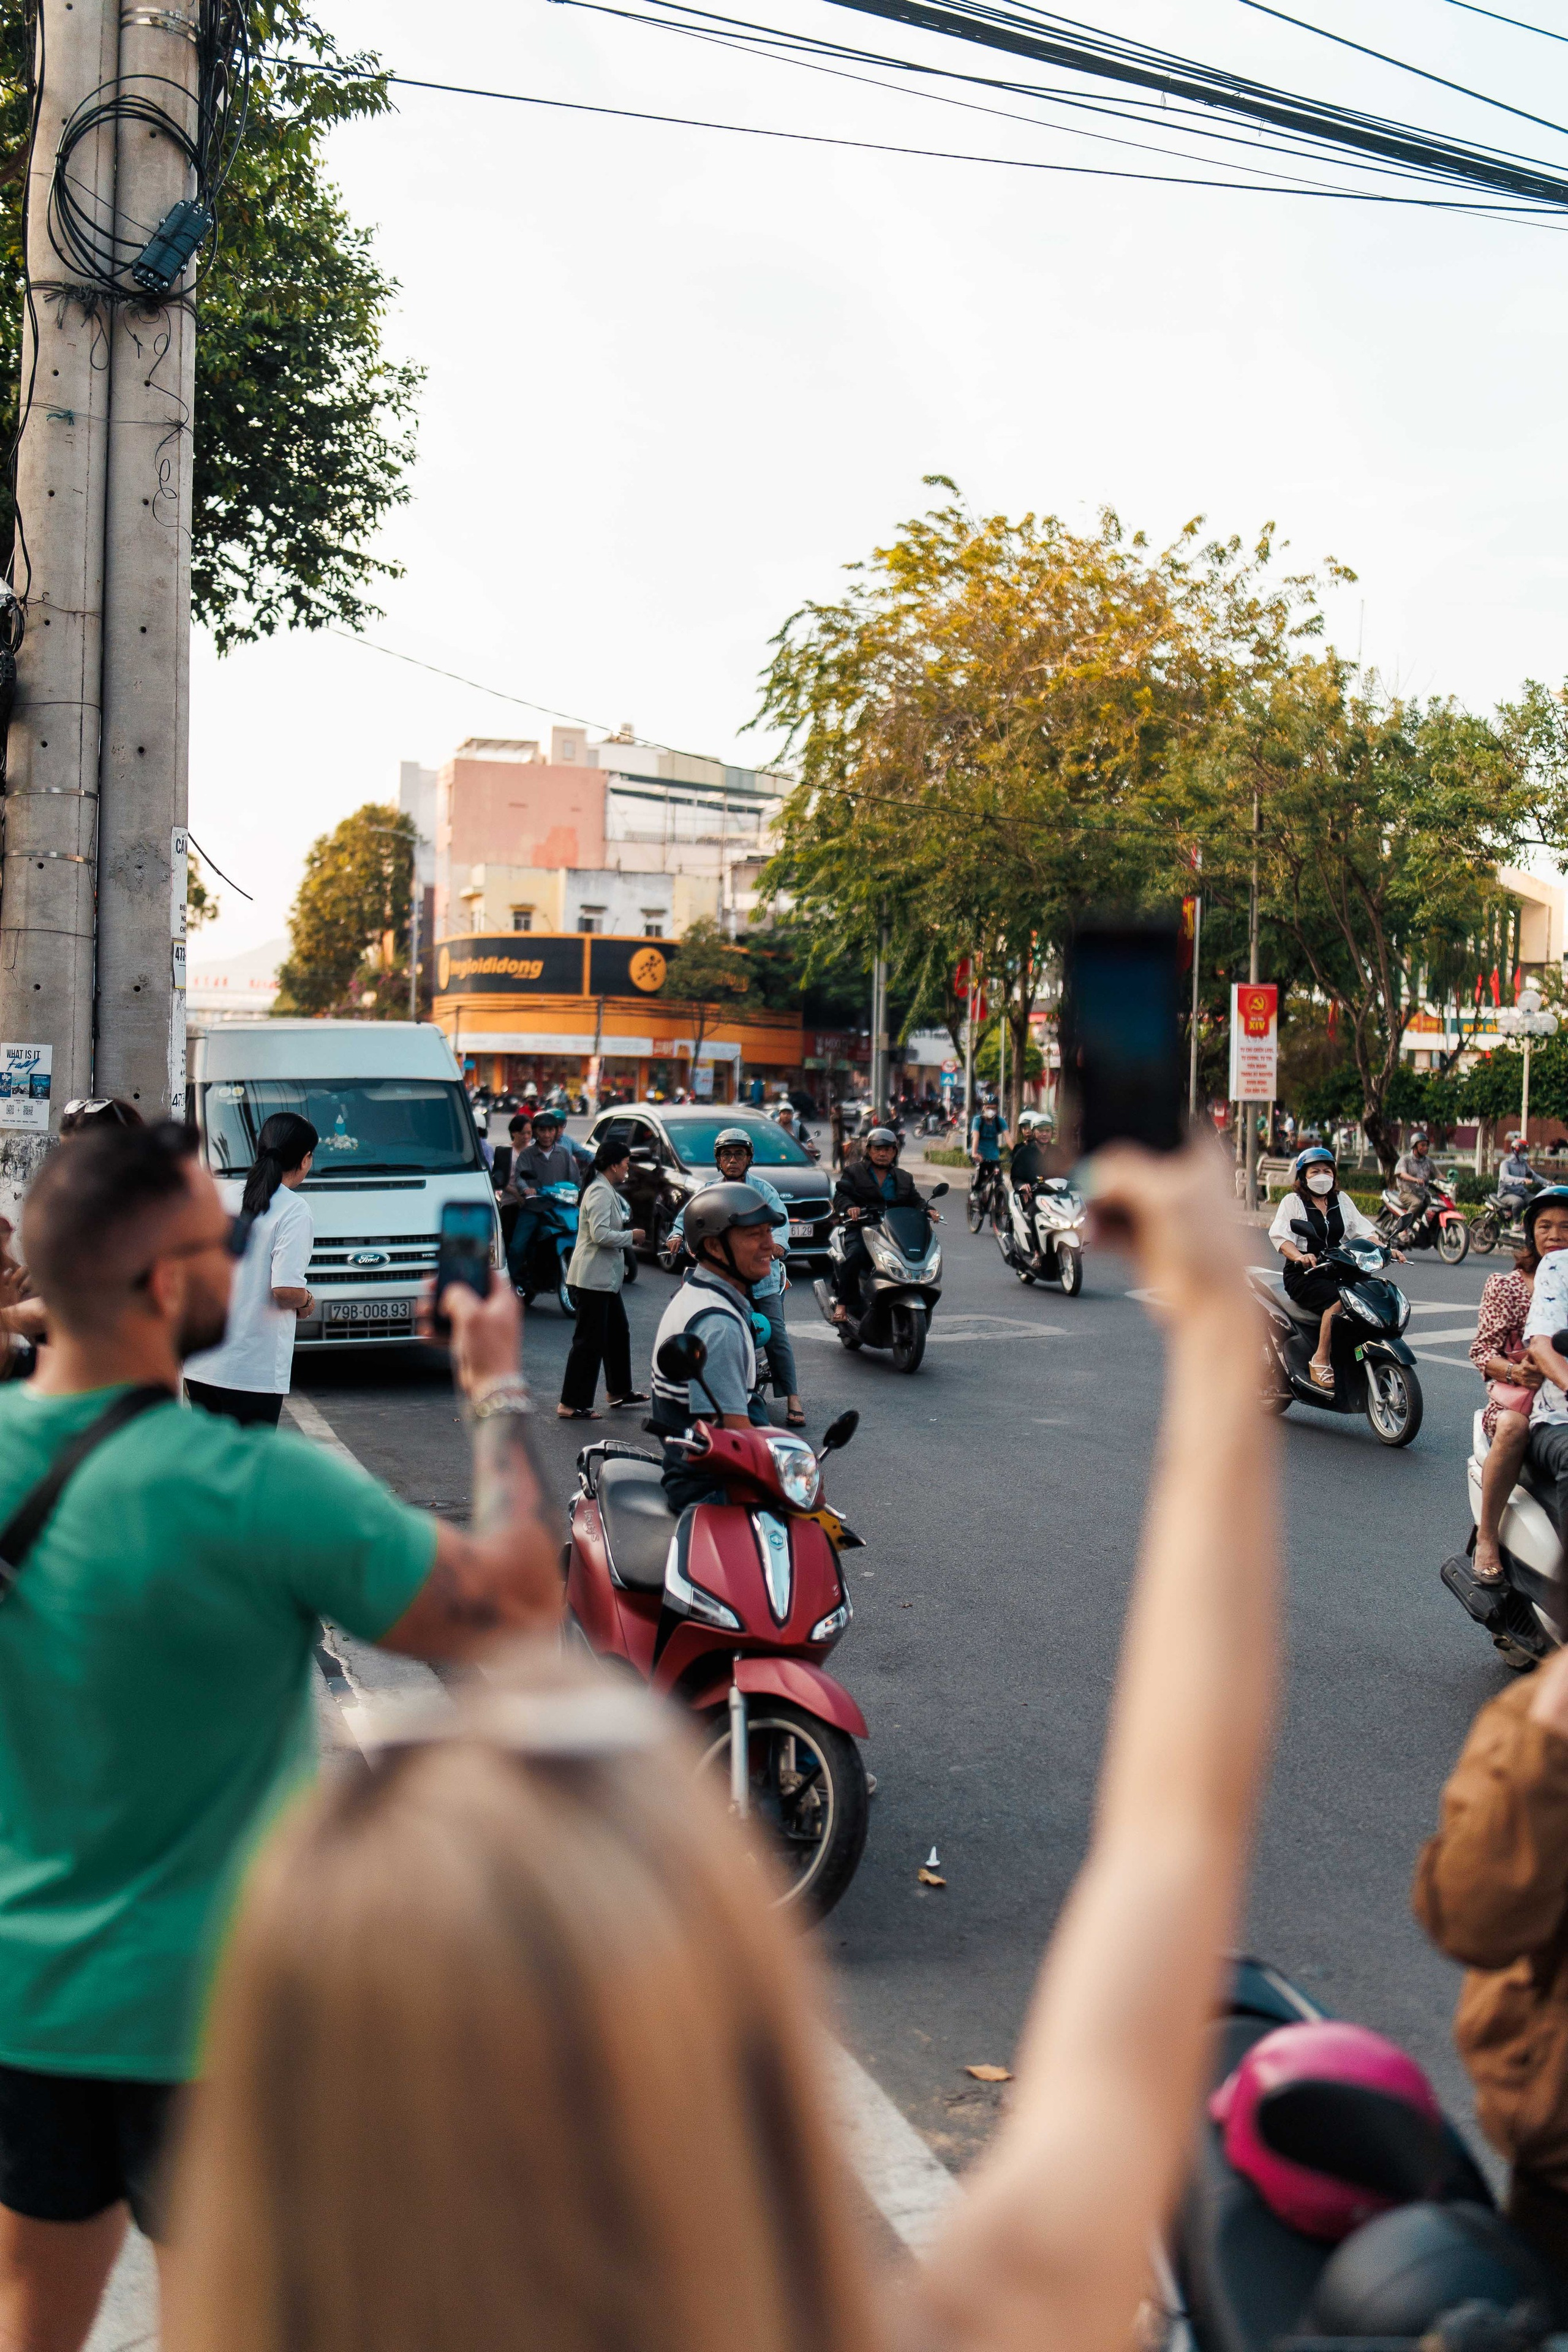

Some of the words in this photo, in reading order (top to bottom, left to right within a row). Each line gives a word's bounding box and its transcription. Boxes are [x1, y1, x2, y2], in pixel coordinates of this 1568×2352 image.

[7, 1049, 23, 1059] WHAT
[25, 1050, 32, 1060] IS
[34, 1050, 41, 1060] IT
[358, 1254, 380, 1264] Ford
[333, 1303, 408, 1321] 79B-008.93
